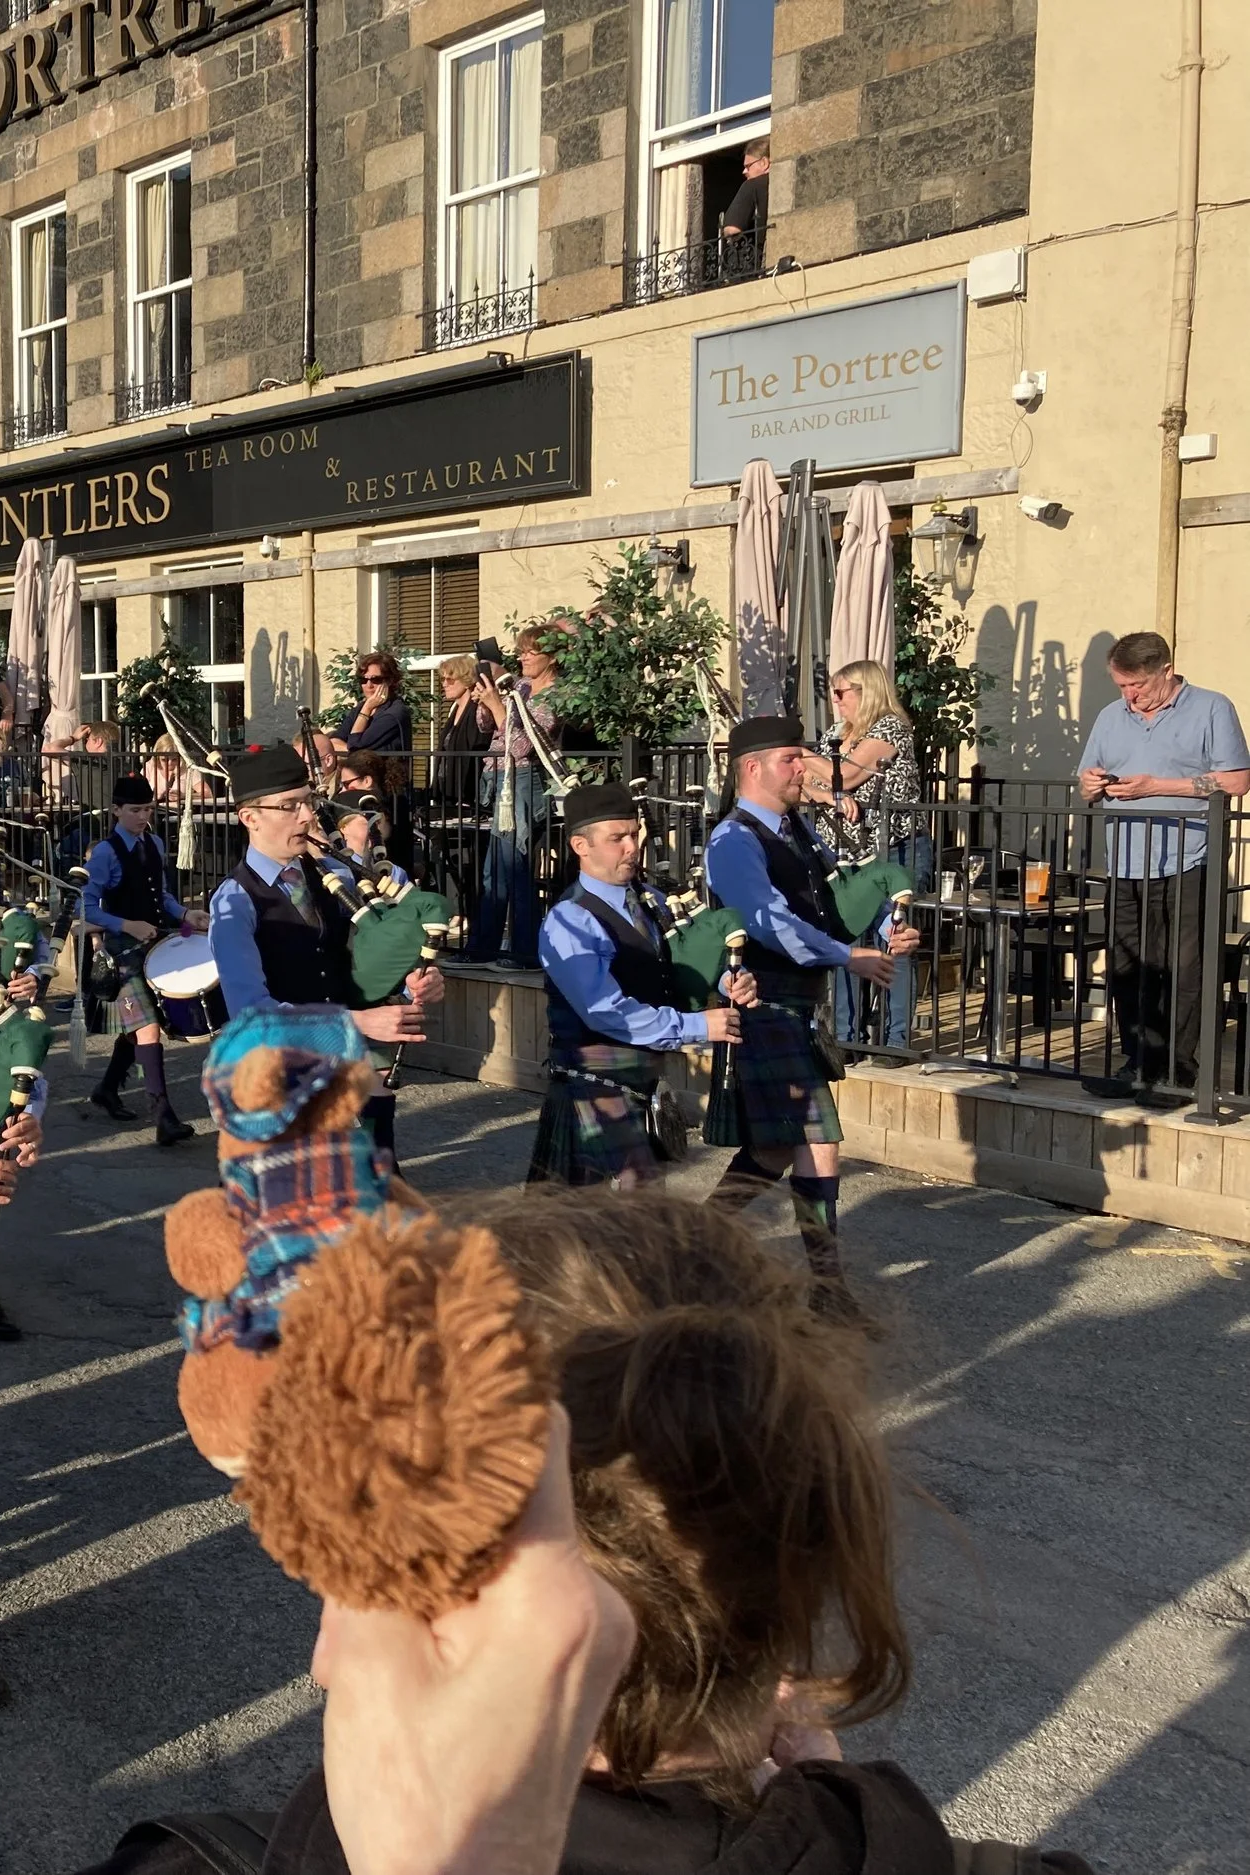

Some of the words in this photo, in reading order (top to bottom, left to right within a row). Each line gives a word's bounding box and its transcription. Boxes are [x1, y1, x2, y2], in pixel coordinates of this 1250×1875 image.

[709, 364, 779, 406] The
[792, 344, 944, 394] Portree
[751, 420, 785, 439] BAR
[789, 413, 830, 433] AND
[835, 404, 891, 426] GRILL
[185, 447, 229, 472] TEA
[242, 426, 319, 462] ROOM
[325, 457, 341, 478] &
[346, 446, 561, 504] RESTAURANT
